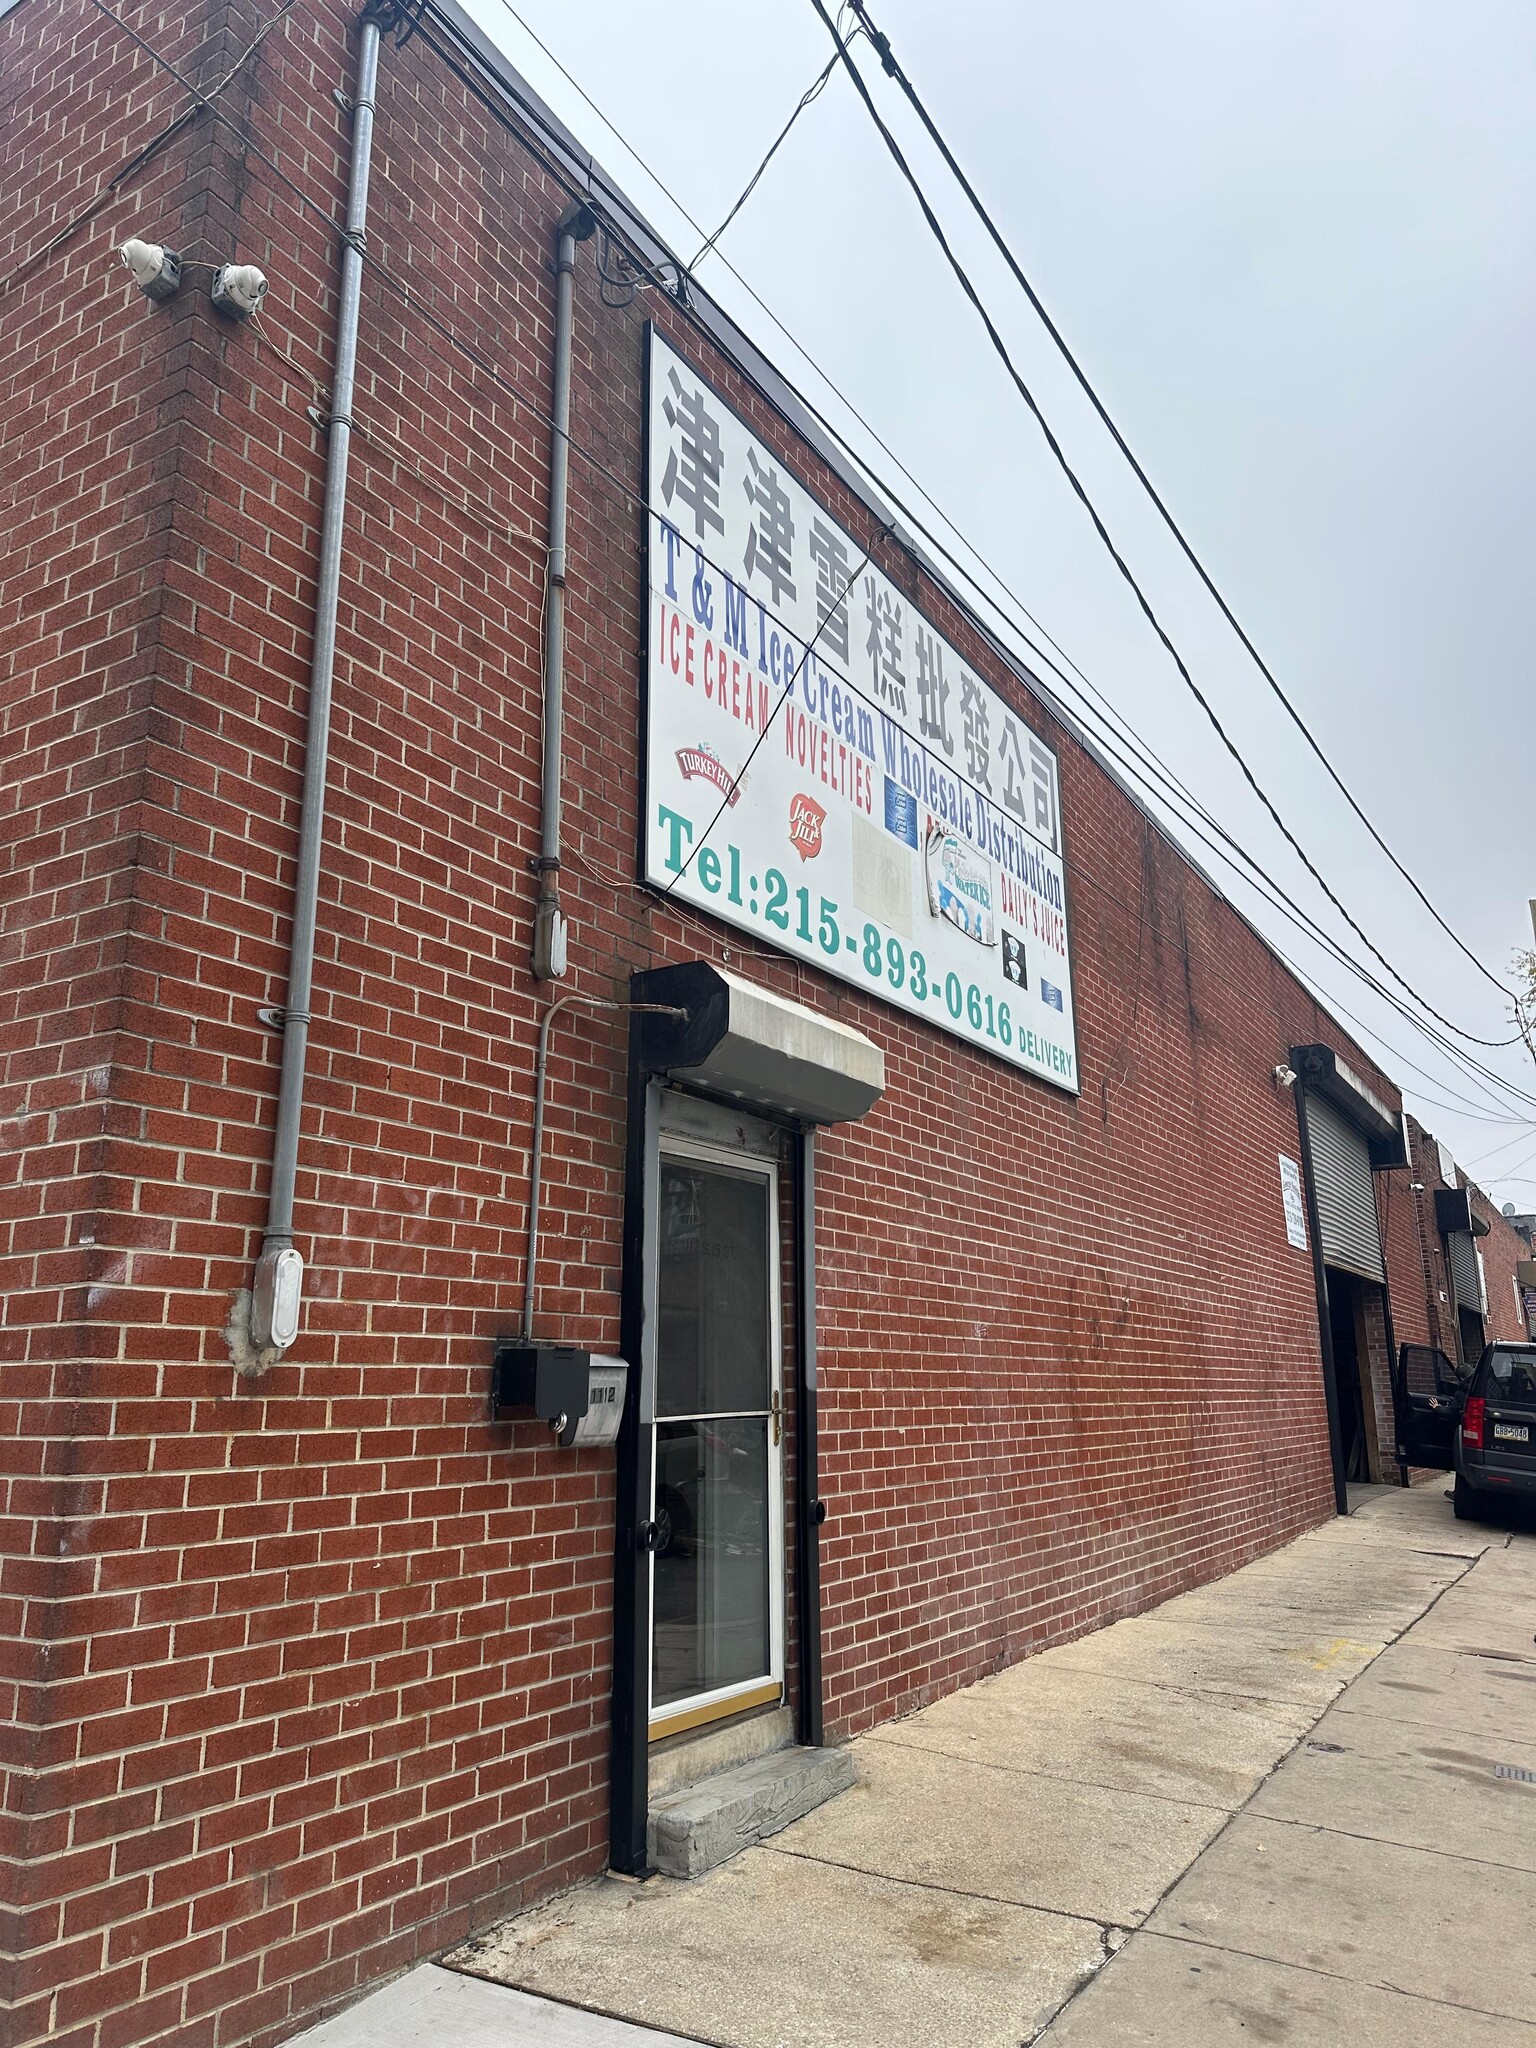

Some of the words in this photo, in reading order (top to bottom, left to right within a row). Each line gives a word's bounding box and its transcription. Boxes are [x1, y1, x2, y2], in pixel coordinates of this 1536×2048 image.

[660, 365, 1061, 858] 津津雪糕批發公司
[660, 604, 695, 687] ICE
[703, 639, 769, 740] CREAM
[785, 700, 873, 815] NOVELTIES
[660, 515, 680, 601] T
[691, 544, 714, 632] &
[723, 570, 749, 660] M
[758, 599, 796, 697] Ice
[802, 642, 876, 762] Cream
[880, 706, 974, 840] Wholesale
[975, 790, 1062, 911] Distribution
[679, 752, 717, 781] TURKEY
[716, 767, 736, 801] HILL
[790, 800, 821, 829] JACK
[790, 820, 815, 845] JILL
[1001, 872, 1038, 937] DAILY'S
[1041, 903, 1065, 957] JUICE
[1019, 1026, 1073, 1079] DELIVERY
[591, 1387, 616, 1403] 1112
